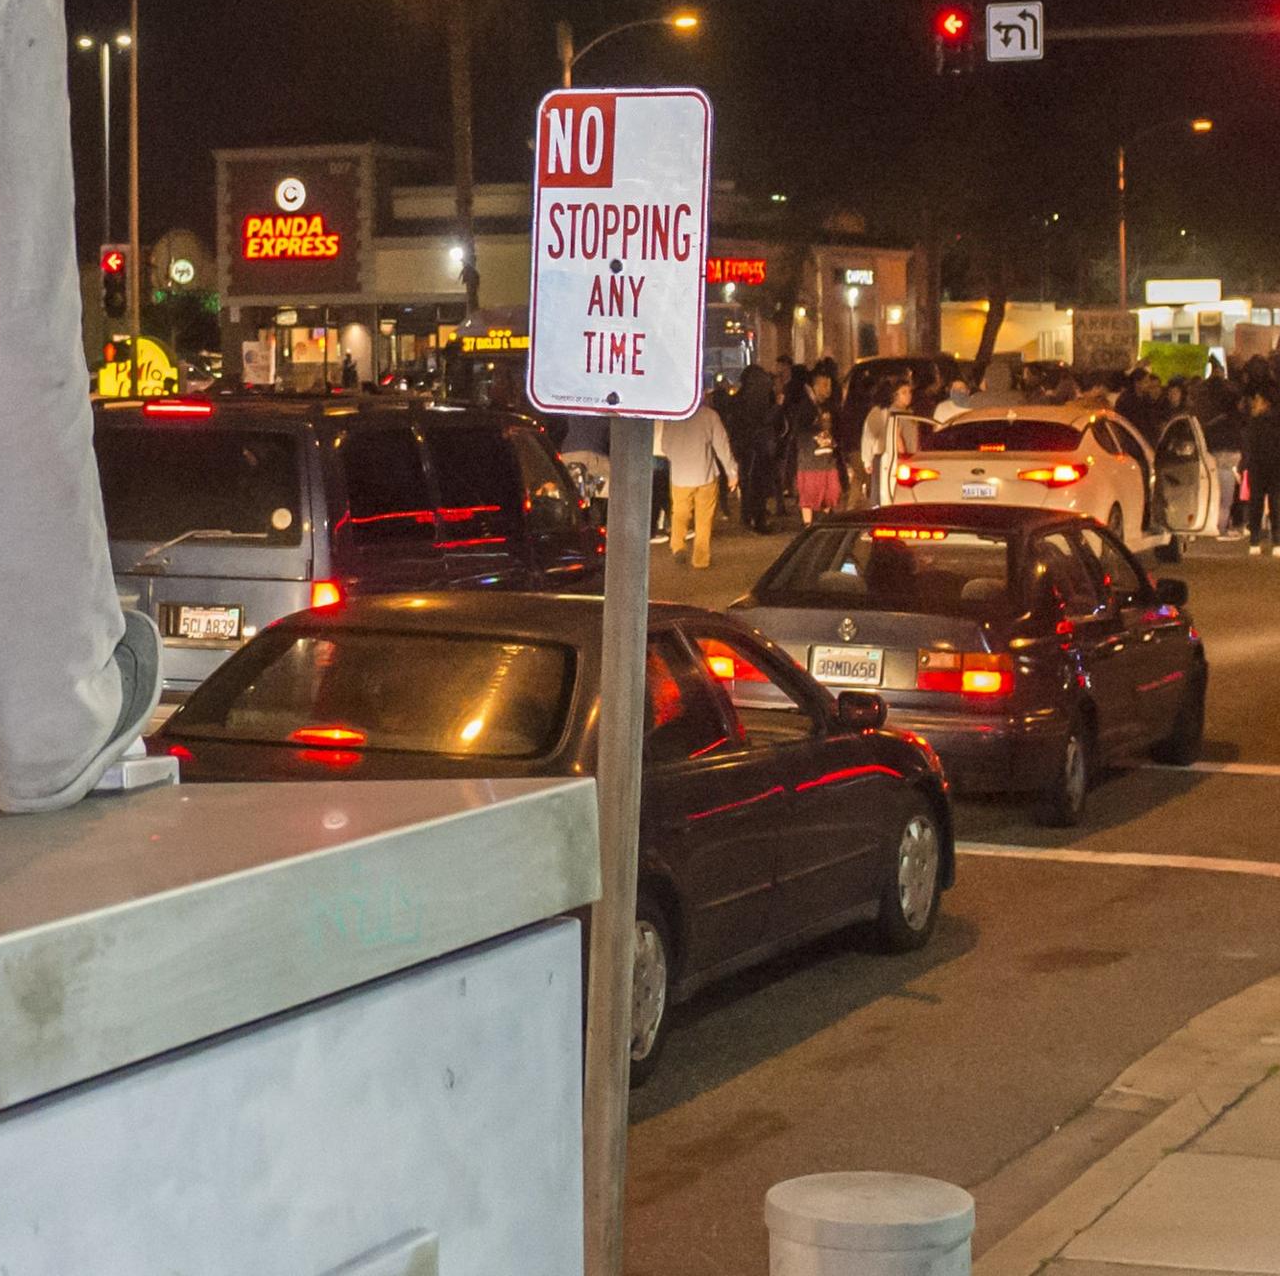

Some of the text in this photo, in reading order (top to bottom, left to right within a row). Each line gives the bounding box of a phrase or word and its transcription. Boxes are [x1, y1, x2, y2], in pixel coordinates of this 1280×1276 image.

[548, 106, 604, 175] NO
[246, 215, 324, 238] PANDA
[548, 202, 692, 262] STOPPING
[246, 235, 339, 258] EXPRESS
[587, 275, 646, 318] ANY
[583, 331, 646, 376] TIME
[116, 361, 162, 382] Pllo
[118, 380, 163, 397] Lco
